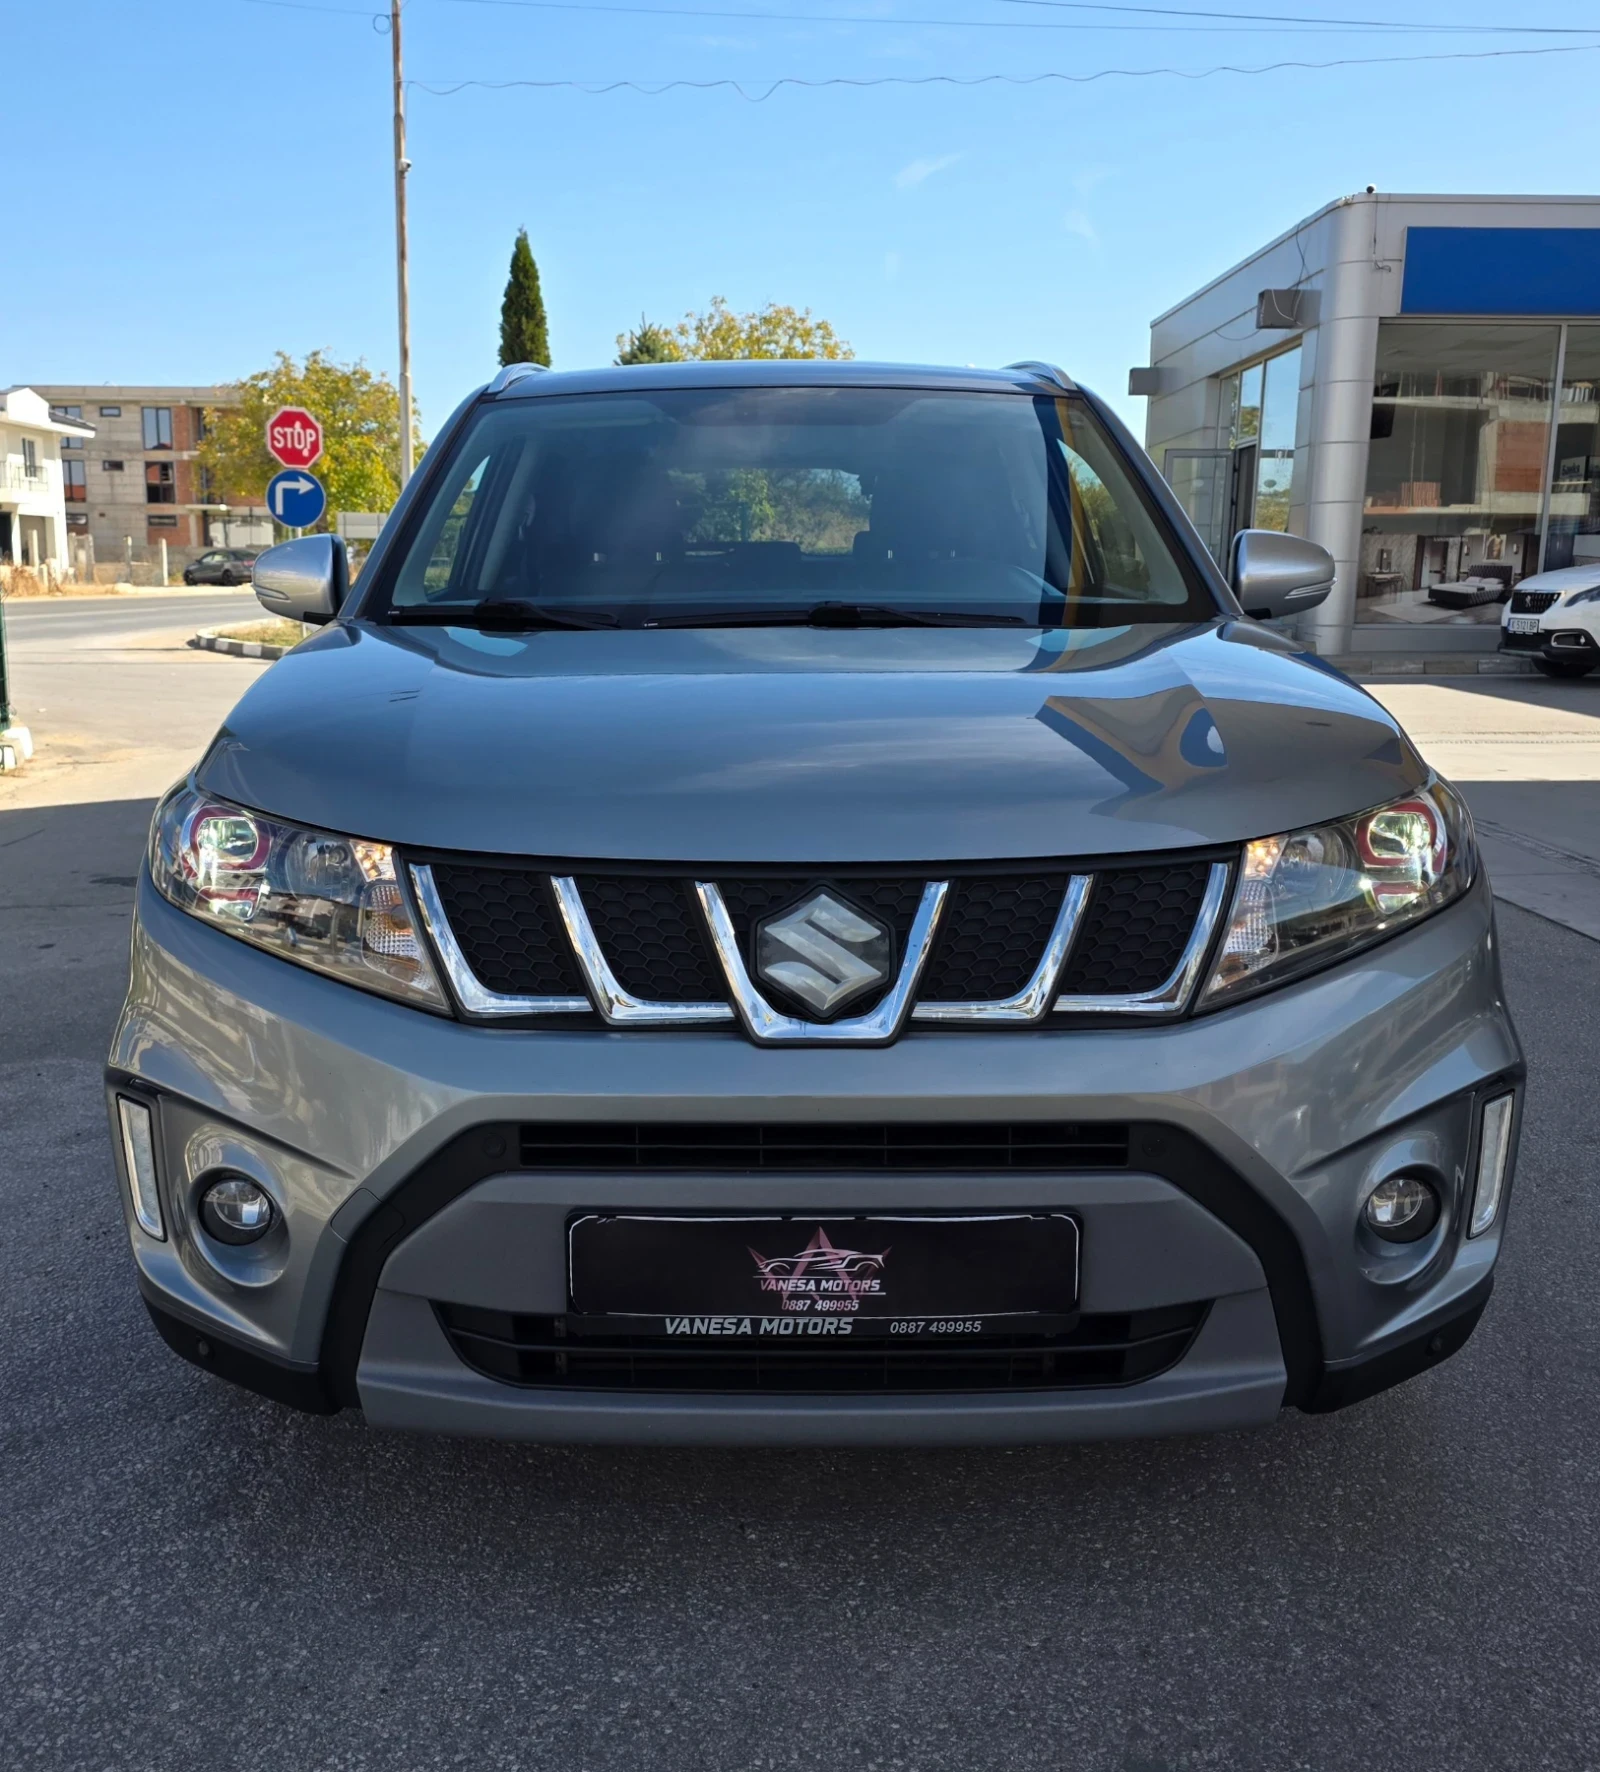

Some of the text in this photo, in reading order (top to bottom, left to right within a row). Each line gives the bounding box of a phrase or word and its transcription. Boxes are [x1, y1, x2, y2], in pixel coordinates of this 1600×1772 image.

[273, 426, 317, 450] STOP
[760, 1279, 881, 1292] VANESA MOTORS
[781, 1299, 860, 1311] 0887 499955
[665, 1318, 854, 1335] VANESA MOTORS
[889, 1320, 982, 1334] 0887 499955
